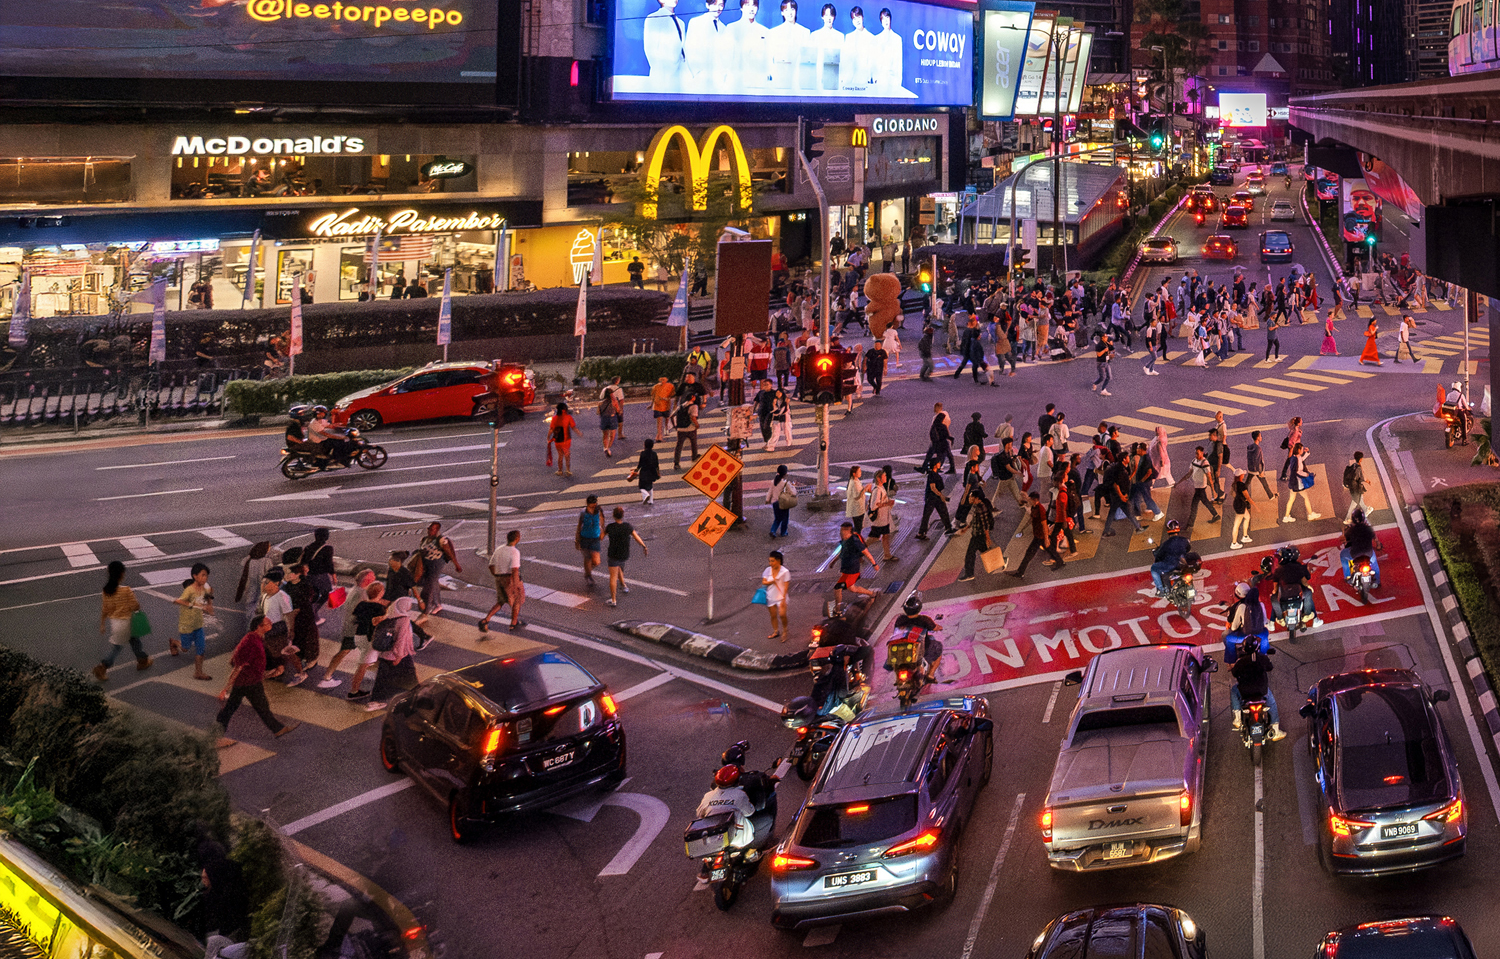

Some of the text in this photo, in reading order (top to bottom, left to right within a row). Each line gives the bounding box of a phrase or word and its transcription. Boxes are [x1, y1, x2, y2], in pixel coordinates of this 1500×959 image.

[996, 40, 1010, 89] acer
[873, 117, 938, 134] GIORDANO
[172, 136, 364, 155] McDonald's
[309, 208, 507, 237] Kadir Pasembor
[1027, 577, 1396, 663] MOTOSAL
[708, 799, 735, 807] KOREA
[850, 872, 871, 884] 3883
